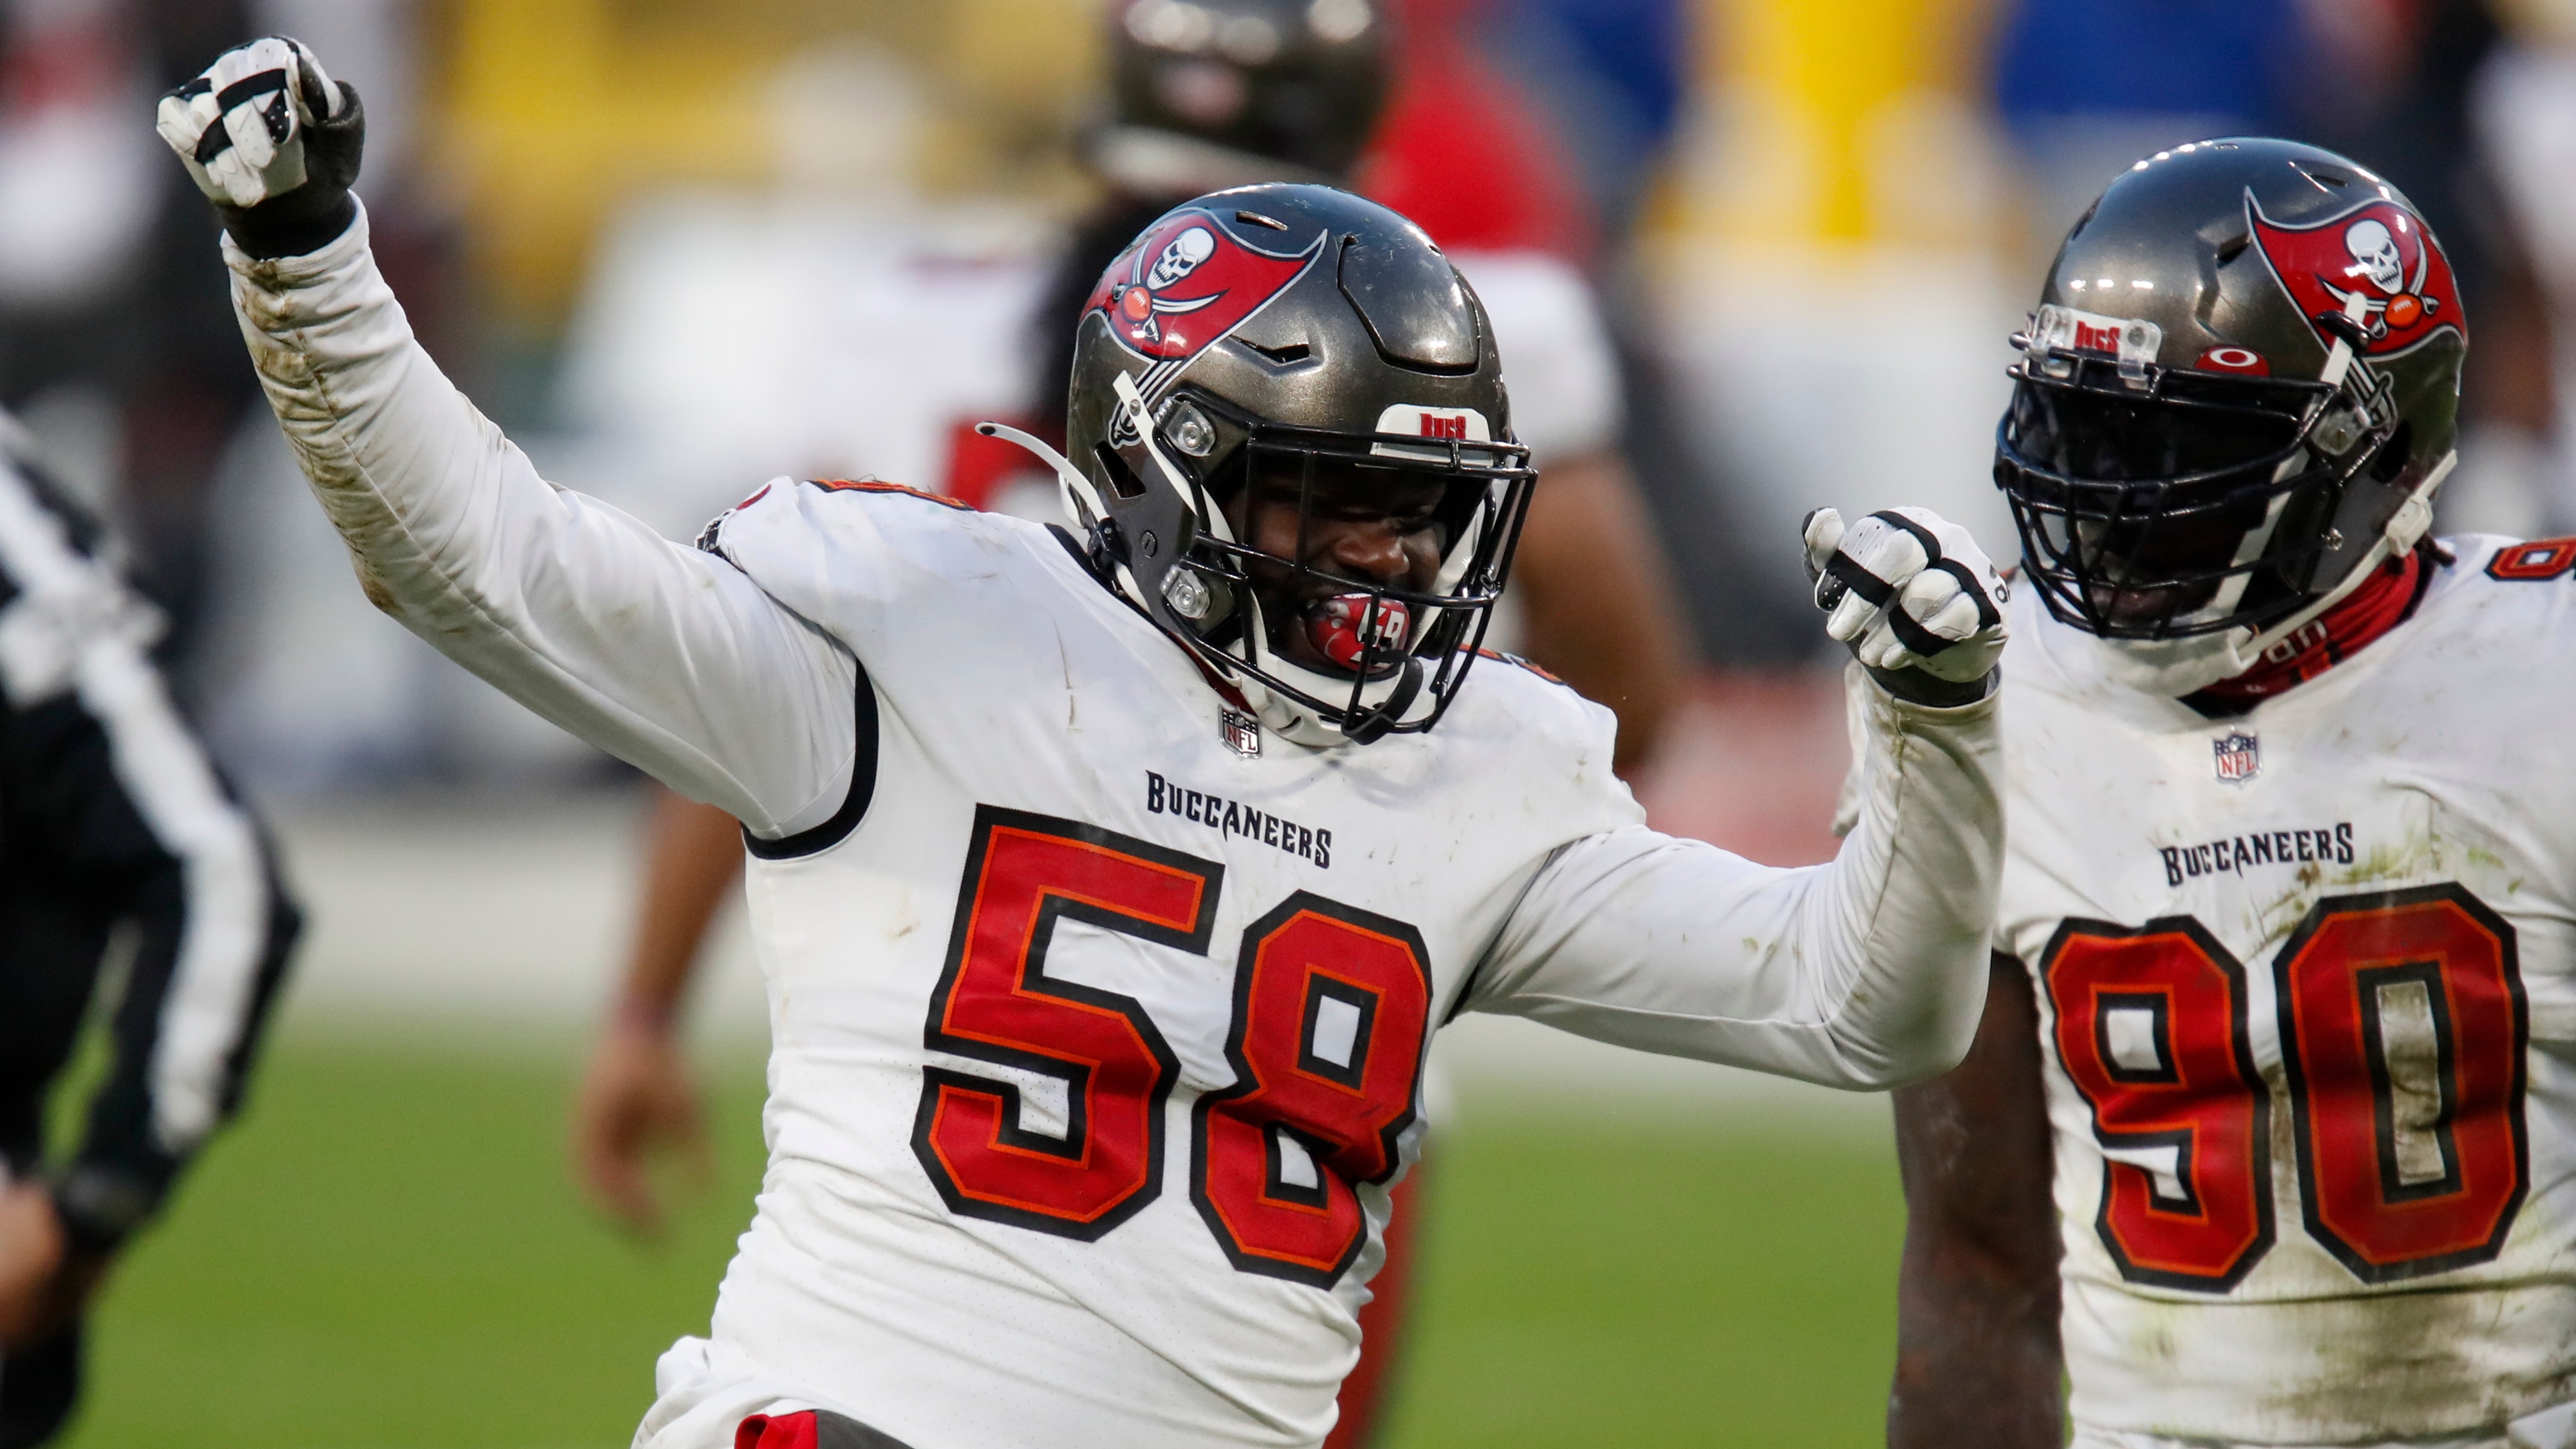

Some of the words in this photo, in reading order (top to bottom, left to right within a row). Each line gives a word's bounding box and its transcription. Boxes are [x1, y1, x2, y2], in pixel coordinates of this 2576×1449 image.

[1225, 723, 1256, 751] NFL
[2218, 751, 2256, 776] NFL
[1145, 770, 1332, 869] BUCCANEERS
[2159, 822, 2354, 887] BUCCANEERS
[910, 802, 1433, 1291] 58
[2039, 881, 2530, 1294] 90
